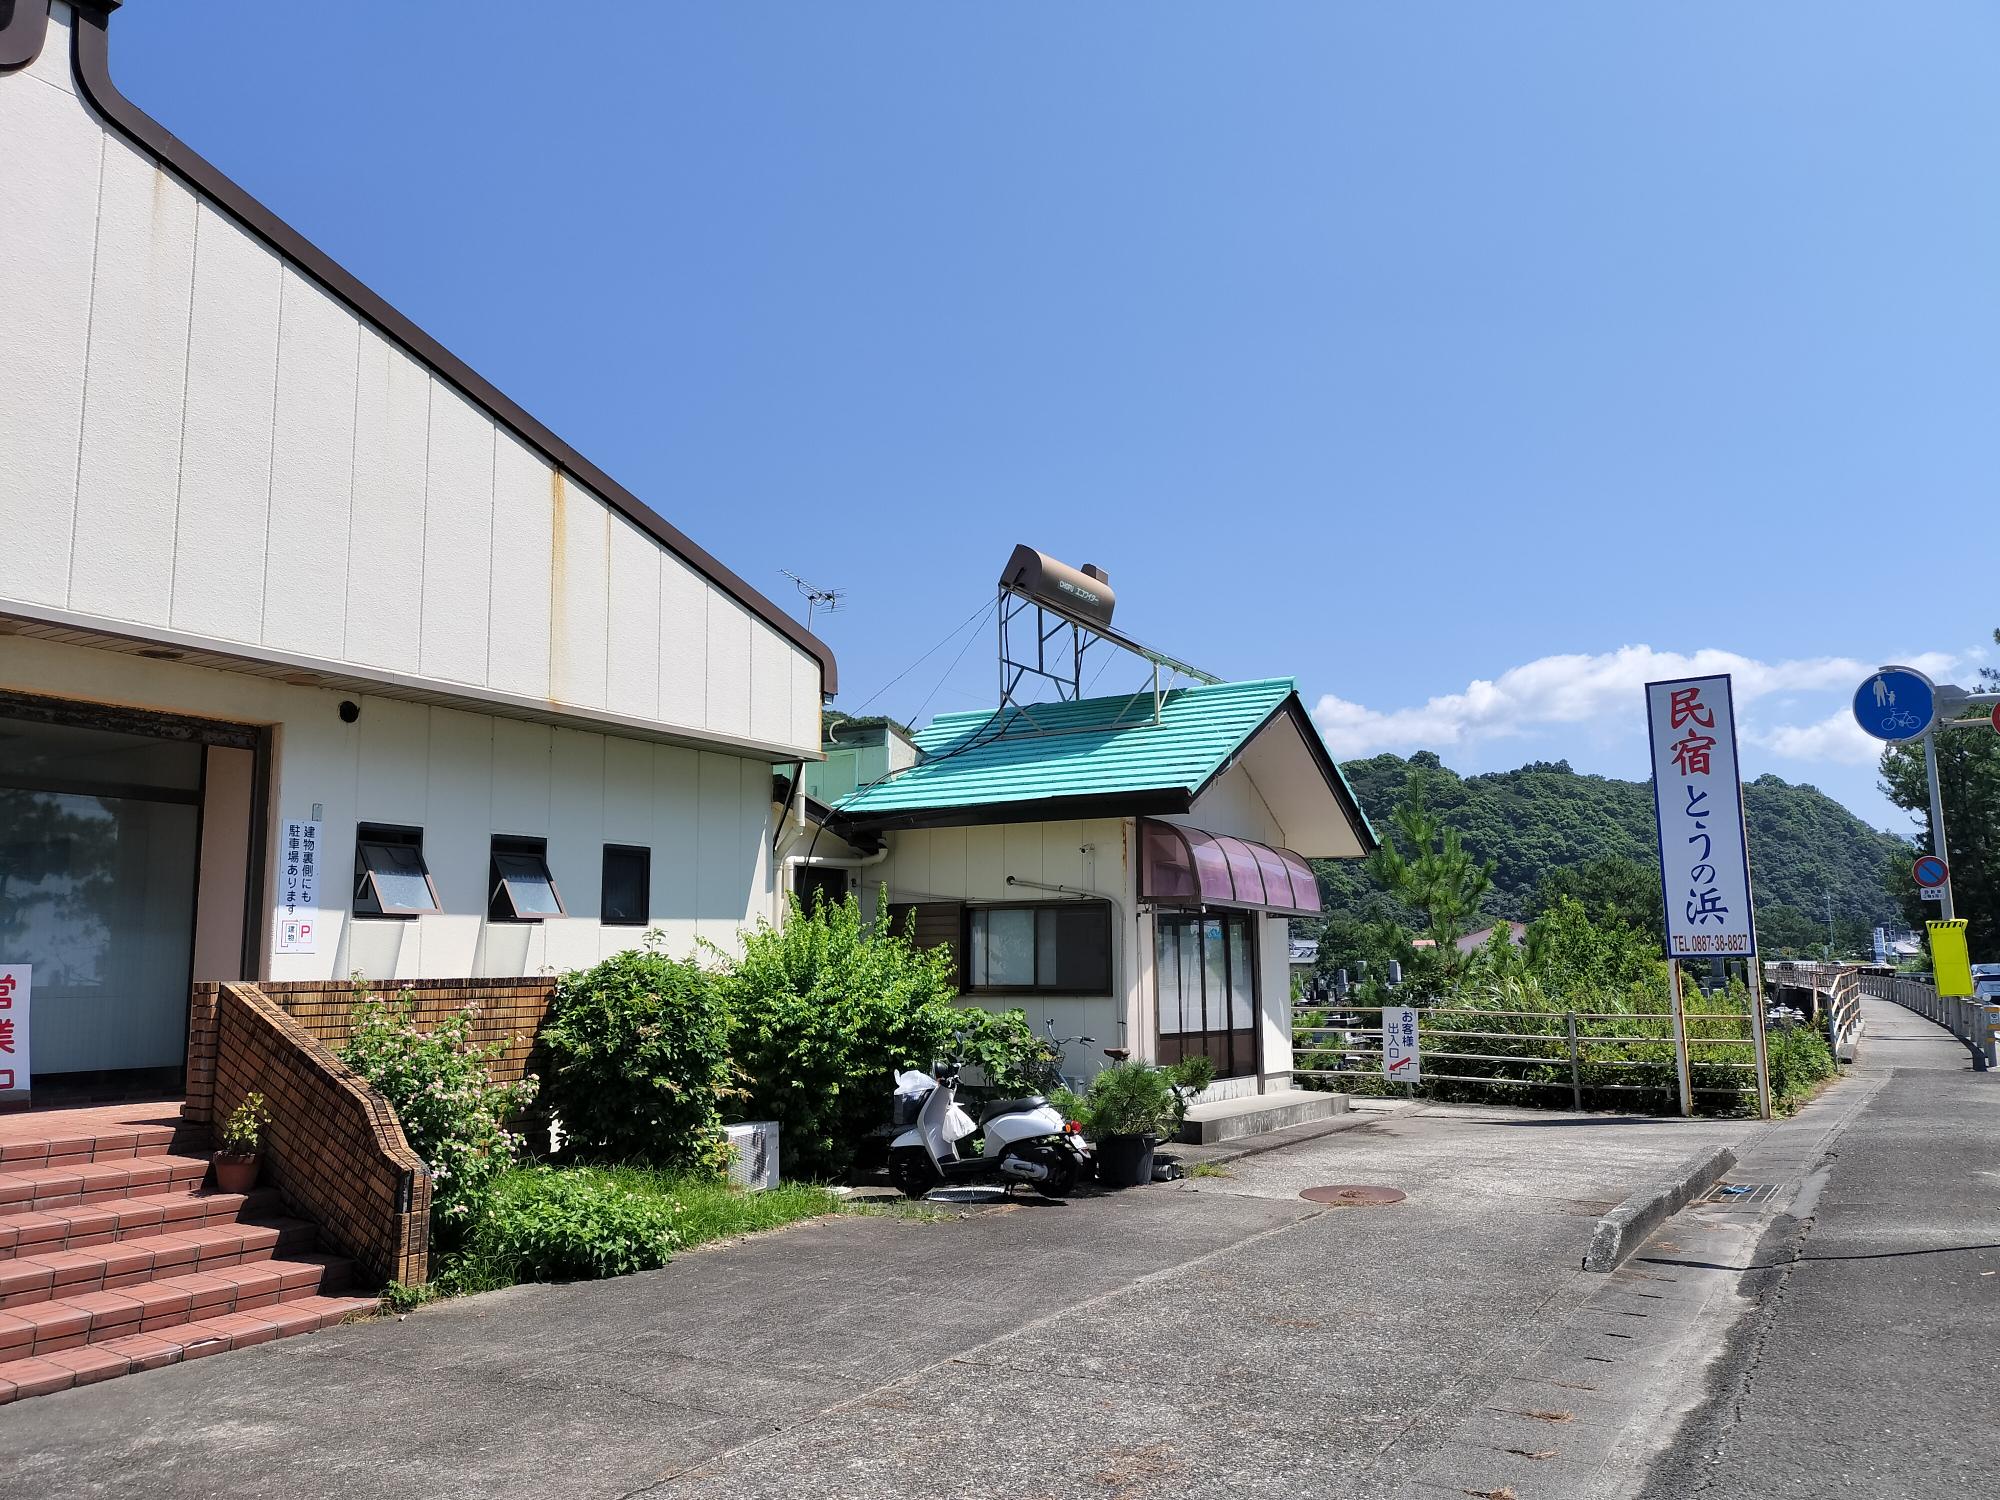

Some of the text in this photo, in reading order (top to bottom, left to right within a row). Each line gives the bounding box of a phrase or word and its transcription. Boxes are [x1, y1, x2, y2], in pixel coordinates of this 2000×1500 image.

[285, 824, 301, 916] 駐車場あります
[301, 825, 316, 903] 建物裏側にも
[300, 925, 311, 938] P
[1672, 933, 1748, 953] TEL 0887-38-8827
[1387, 1021, 1400, 1059] 出入口
[1401, 1010, 1414, 1048] お客様
